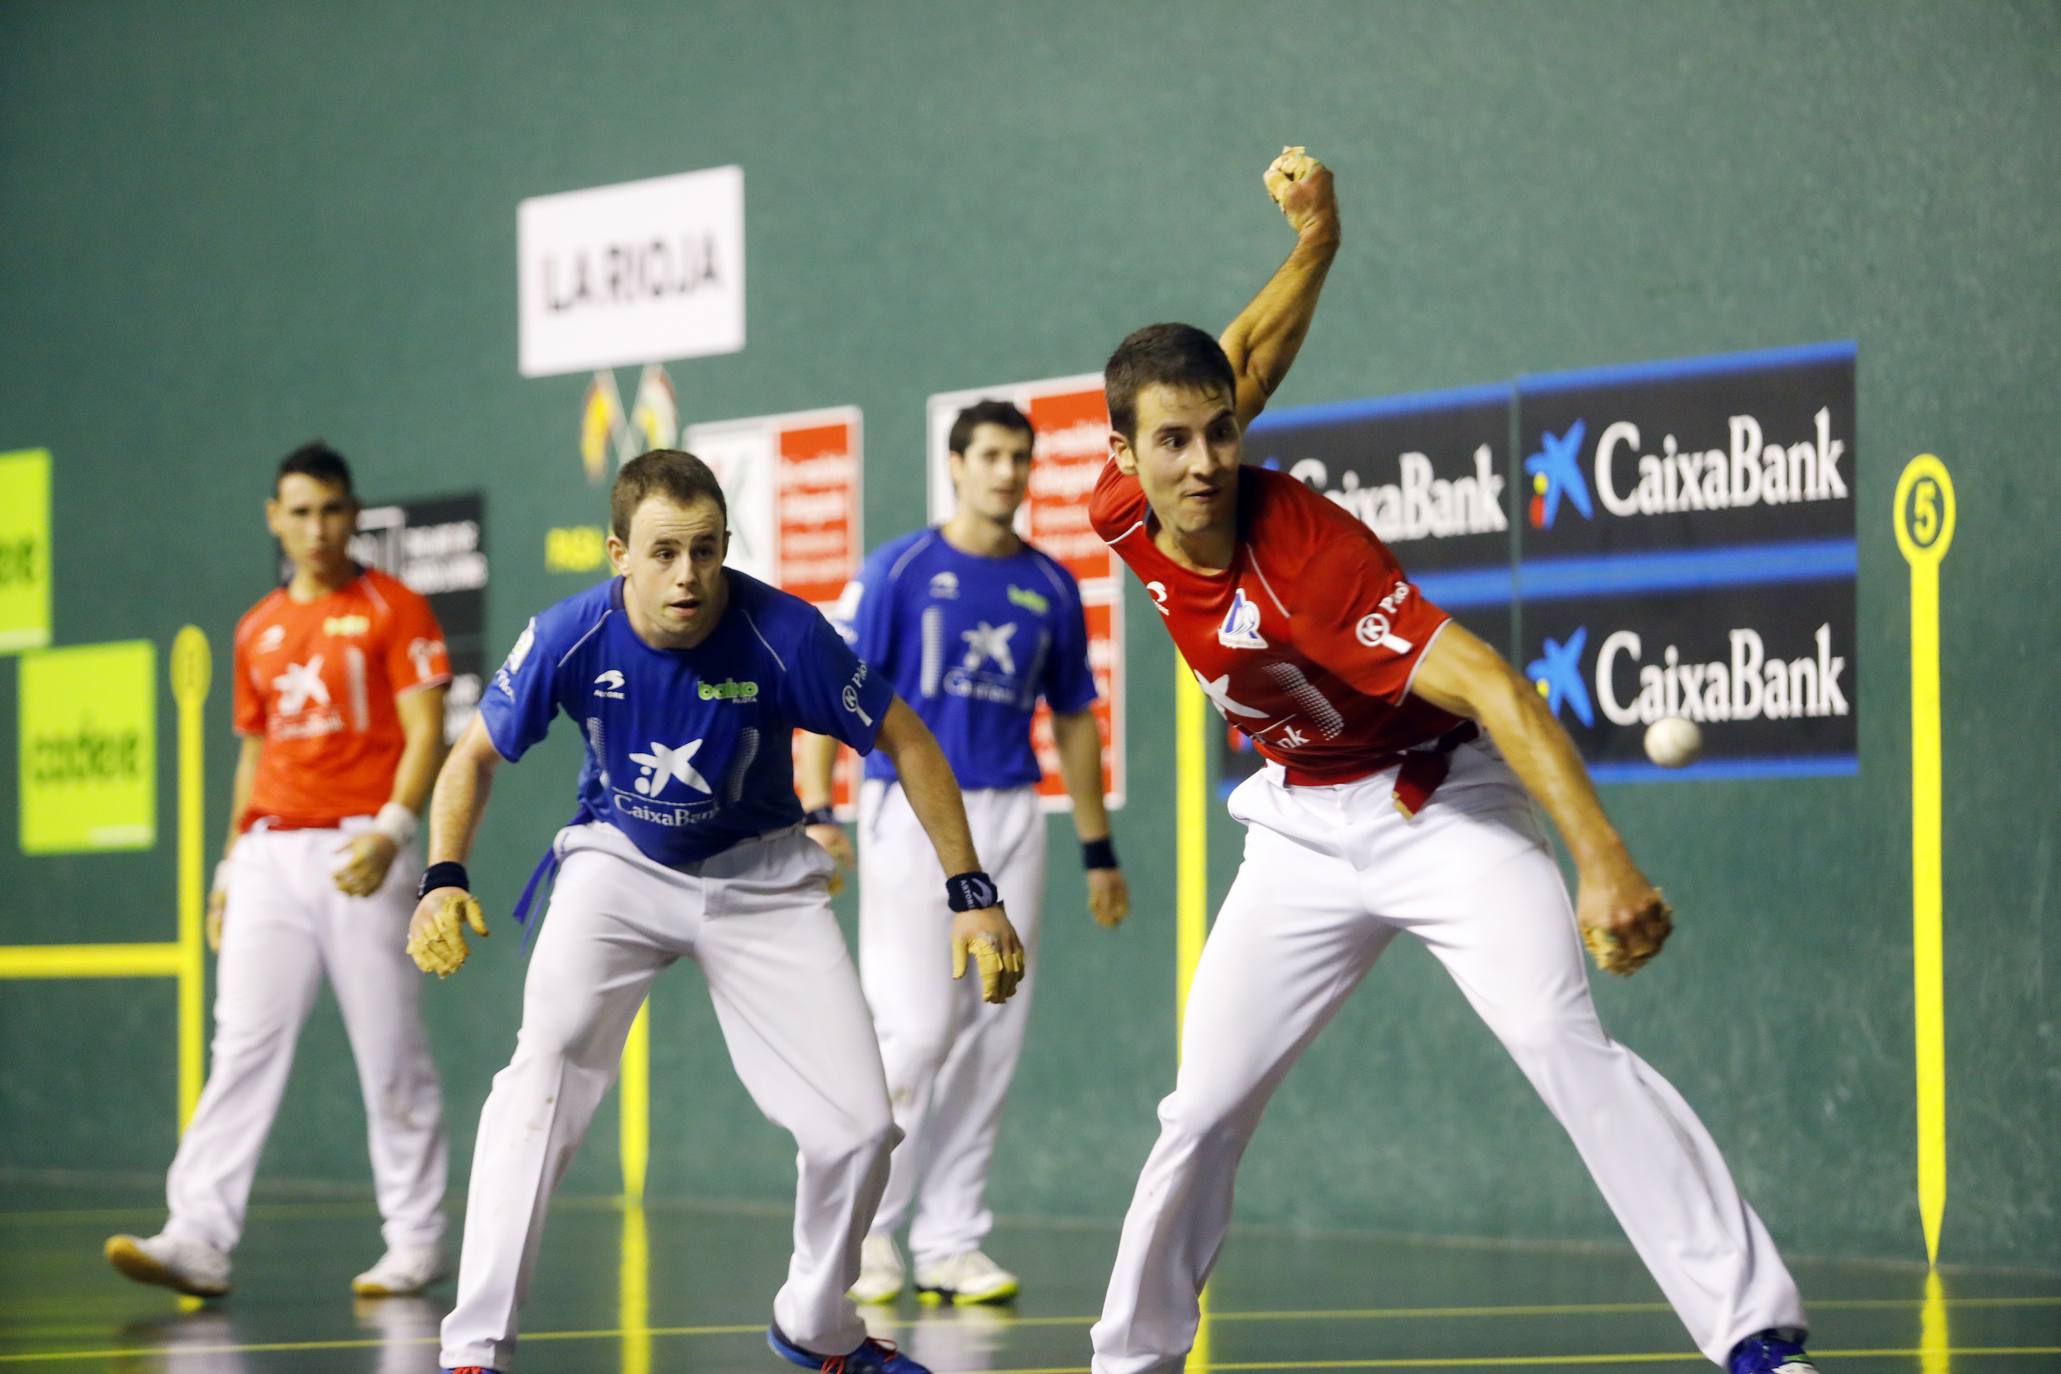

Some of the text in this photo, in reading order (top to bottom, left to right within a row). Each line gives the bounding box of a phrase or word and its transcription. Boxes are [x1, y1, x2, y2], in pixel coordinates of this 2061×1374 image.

[543, 228, 724, 312] LA RIOJA
[1595, 405, 1848, 517] CaixaBank
[1914, 480, 1938, 535] 5
[1596, 622, 1849, 726] CaixaBank
